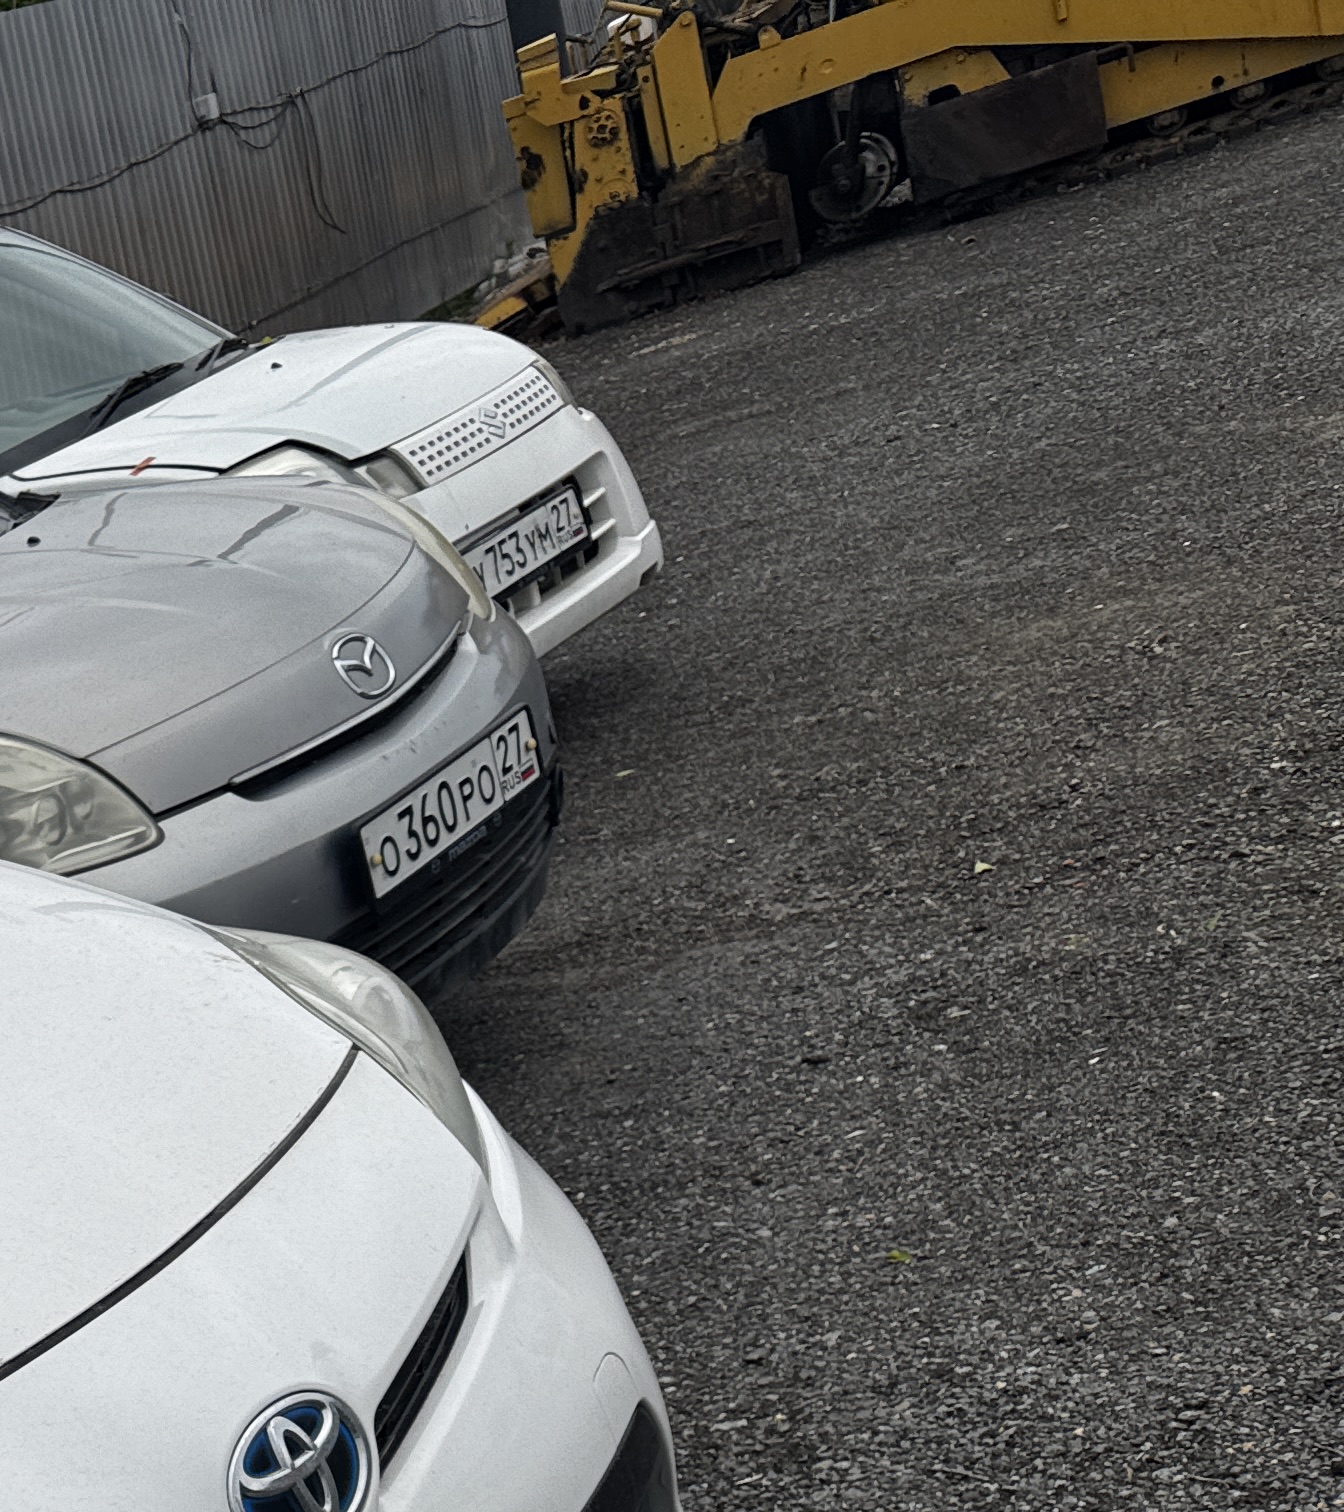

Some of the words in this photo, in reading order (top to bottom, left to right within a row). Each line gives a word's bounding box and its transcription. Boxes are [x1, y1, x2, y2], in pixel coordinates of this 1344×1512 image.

[550, 497, 572, 534] 27
[496, 722, 523, 777] 27
[501, 770, 522, 796] RUS
